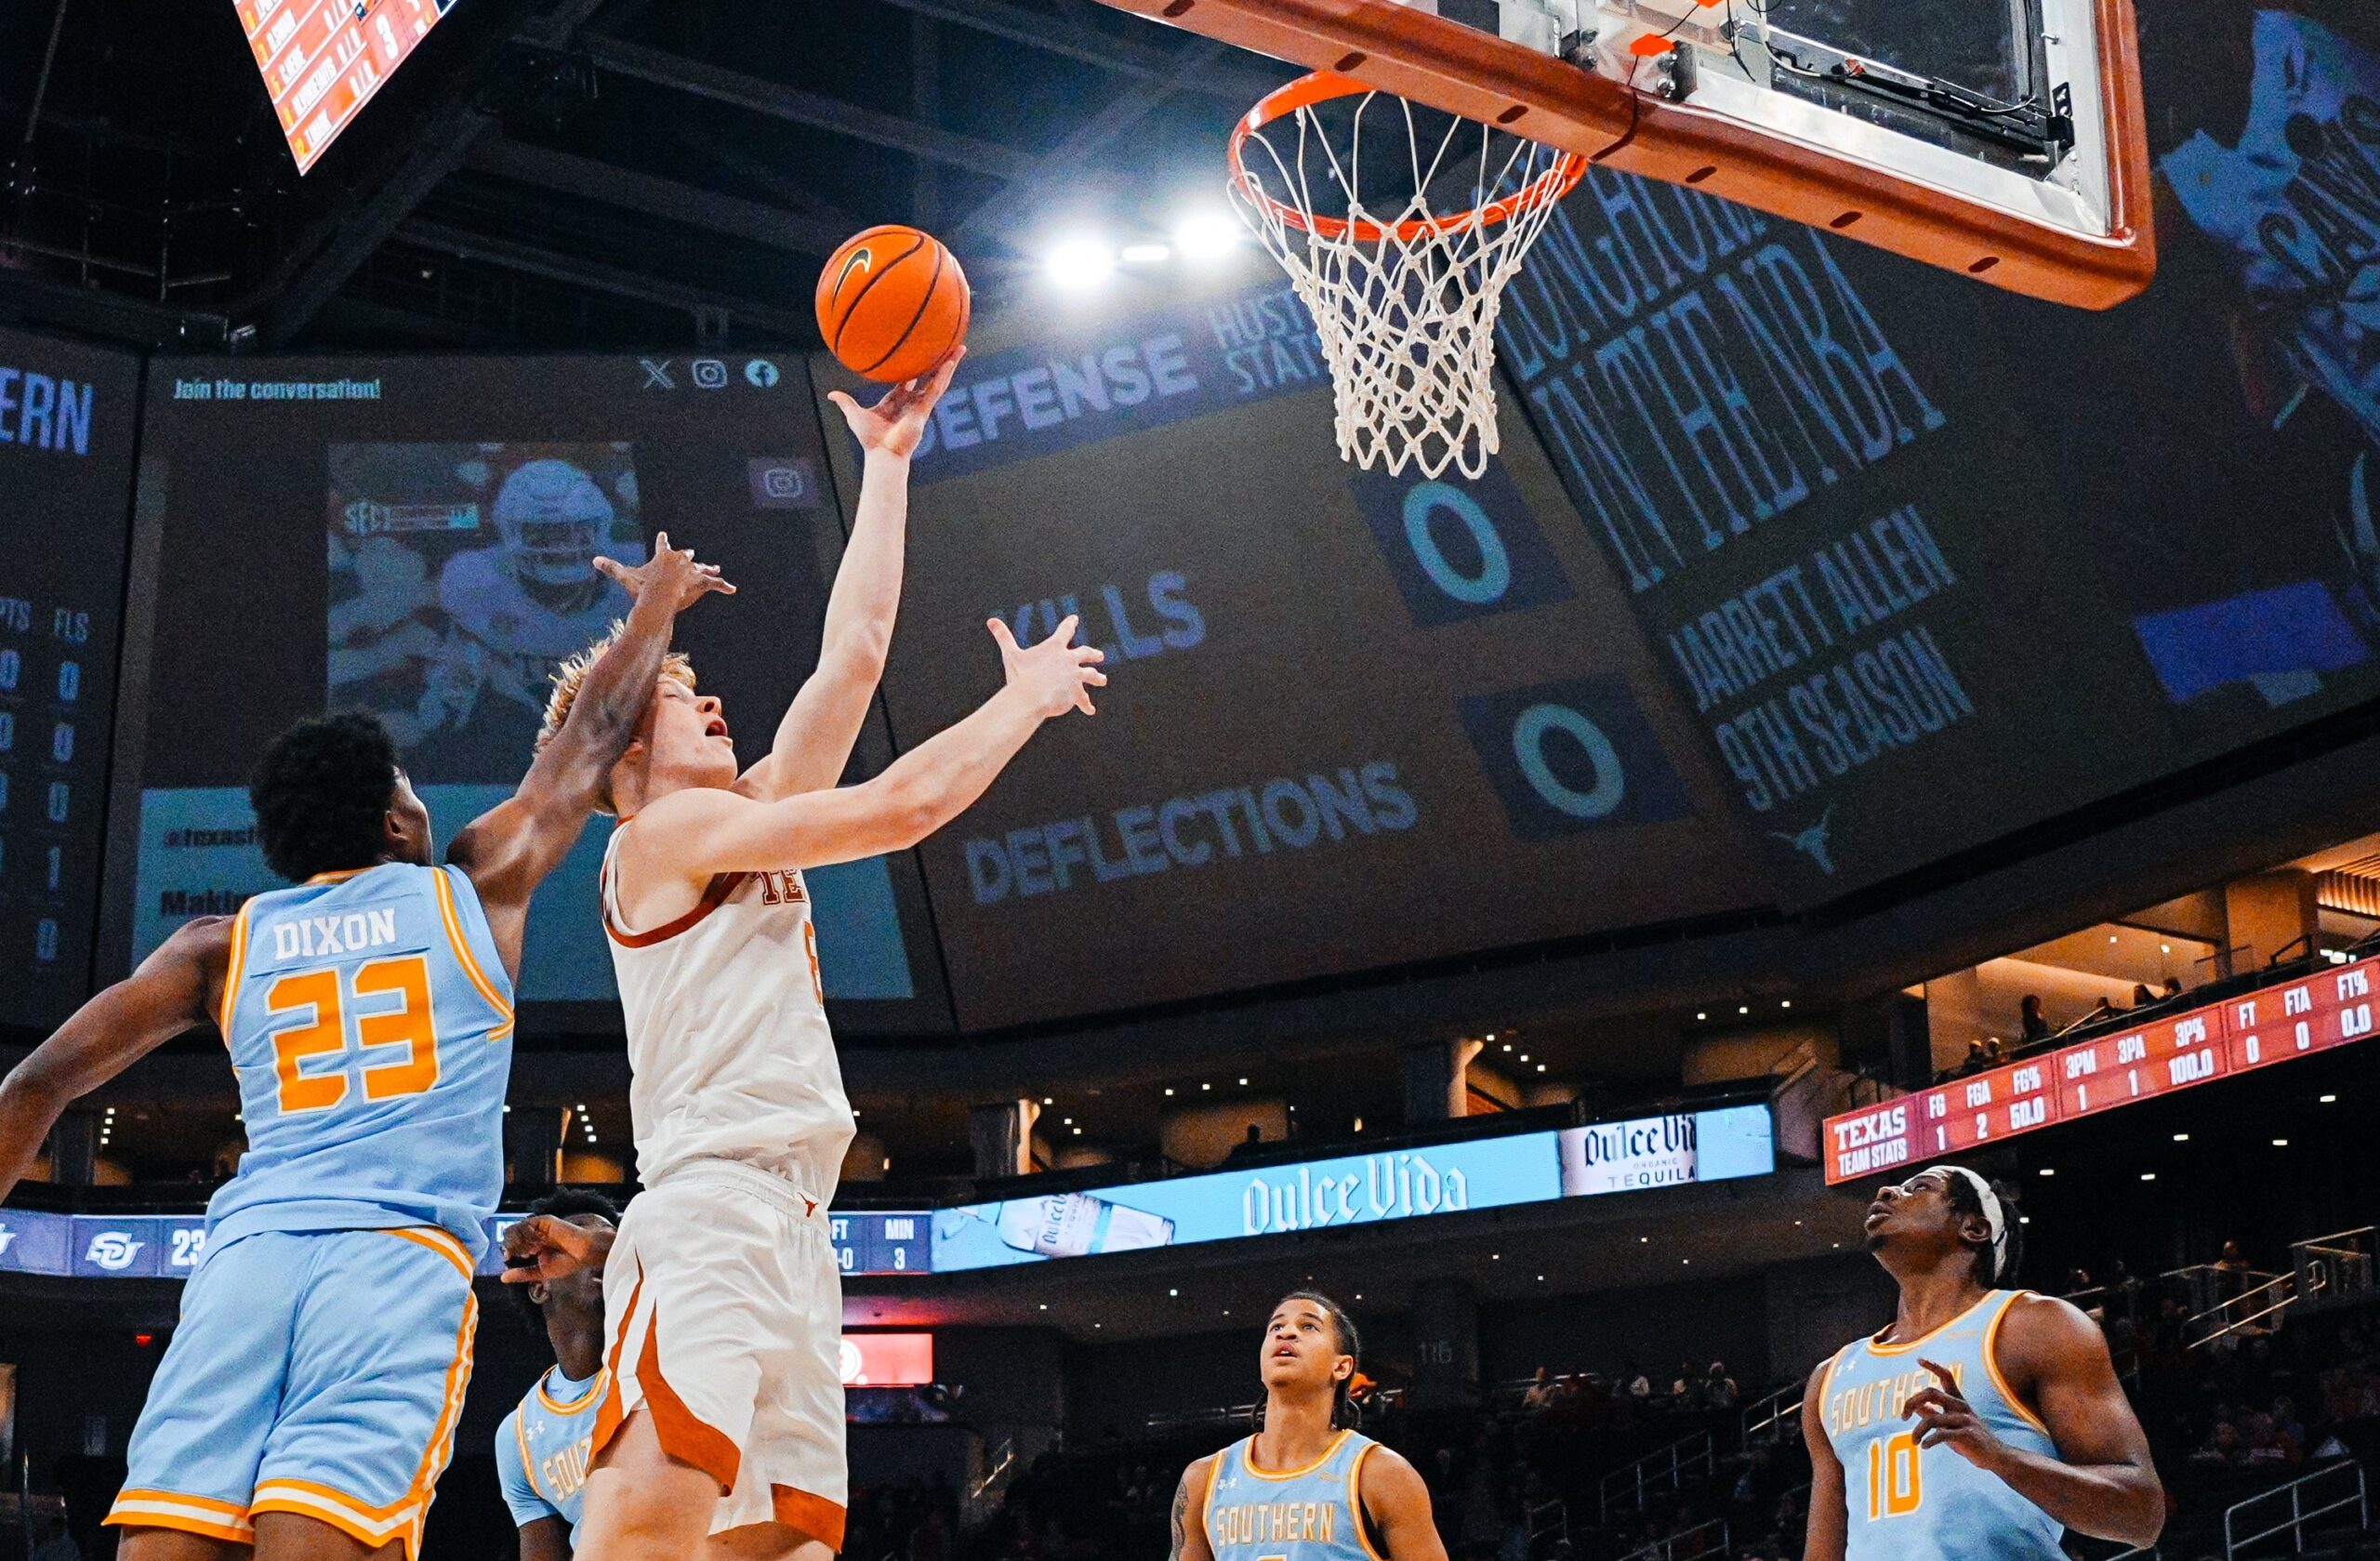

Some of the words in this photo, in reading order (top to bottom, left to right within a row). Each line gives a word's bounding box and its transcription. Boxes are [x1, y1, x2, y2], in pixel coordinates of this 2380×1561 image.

[174, 378, 211, 400] Join
[216, 378, 245, 400] the
[250, 377, 381, 400] conversation!
[1402, 481, 1510, 604] 0
[55, 608, 89, 643] FLS
[1668, 564, 1834, 714] JARRETT
[1813, 503, 1956, 635] ALLEN
[1714, 699, 1819, 812] 9TH
[1789, 625, 1975, 775] SEASON
[1513, 703, 1625, 819] 0
[964, 761, 1419, 906] DEFLECTIONS
[273, 907, 396, 960] DIXON
[2238, 1000, 2256, 1029] FT
[2283, 986, 2312, 1016] FTA
[2336, 969, 2369, 1001] FT%
[264, 953, 441, 1116] 23
[2066, 1049, 2096, 1079] 3PM
[2117, 1034, 2147, 1065] 3PA
[2175, 1016, 2206, 1048] 3P%
[2245, 1035, 2260, 1064] 0
[2294, 1021, 2310, 1051] 0
[2340, 1003, 2373, 1038] 0.0
[1928, 1092, 1947, 1118] FG
[1966, 1079, 1992, 1108] FGA
[2012, 1065, 2043, 1095] FG%
[2077, 1084, 2088, 1111] 1
[2128, 1069, 2138, 1096] 1
[2168, 1048, 2215, 1086] 100.0
[1584, 1122, 1659, 1168] Dulce
[1833, 1105, 1906, 1151] TEXAS
[1936, 1124, 1946, 1151] 1
[1976, 1113, 1988, 1140] 2
[2009, 1098, 2045, 1131] 50.0
[1607, 1165, 1696, 1189] TEQUILA
[1838, 1146, 1871, 1177] TEAM
[1871, 1138, 1907, 1169] STATS
[1243, 1165, 1361, 1237] Dulce
[1368, 1153, 1469, 1219] Vida
[171, 1229, 205, 1266] 23
[885, 1219, 914, 1240] MIN
[894, 1247, 906, 1270] 3
[1868, 1432, 1924, 1523] 10
[1216, 1501, 1336, 1548] SOUTHERN
